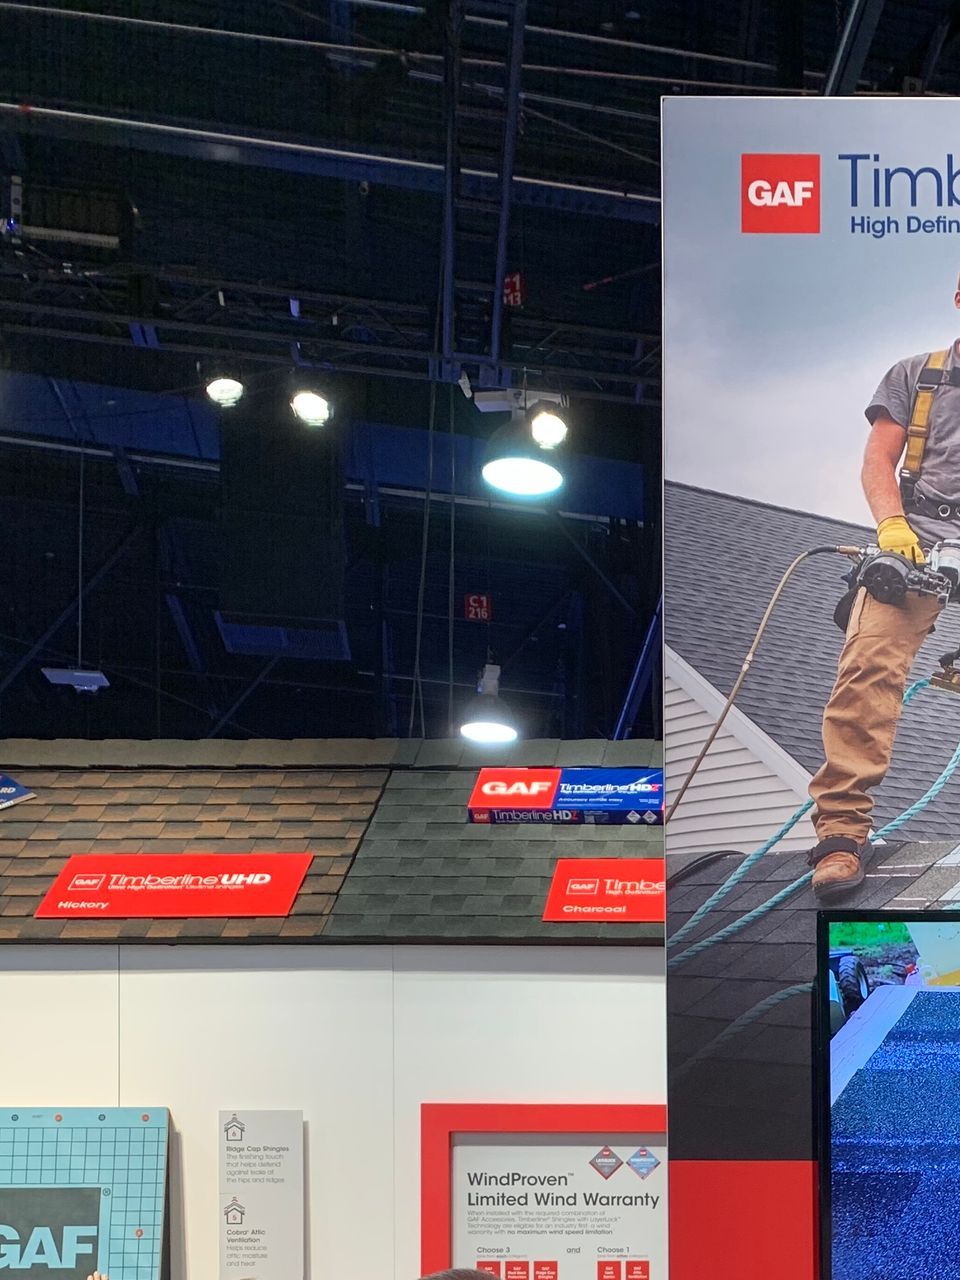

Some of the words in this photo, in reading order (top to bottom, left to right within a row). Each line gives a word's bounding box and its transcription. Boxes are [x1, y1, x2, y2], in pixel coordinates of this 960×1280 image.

[748, 180, 814, 207] GAF
[851, 215, 900, 238] High
[469, 595, 487, 607] C1
[468, 607, 488, 619] 216
[481, 781, 551, 796] GAF
[75, 878, 100, 886] GAF
[221, 873, 271, 885] UHD
[58, 900, 110, 910] Hickory
[562, 905, 627, 913] Charcoal
[467, 1192, 528, 1206] Limited
[534, 1192, 577, 1206] Wind
[583, 1192, 660, 1209] Warranty
